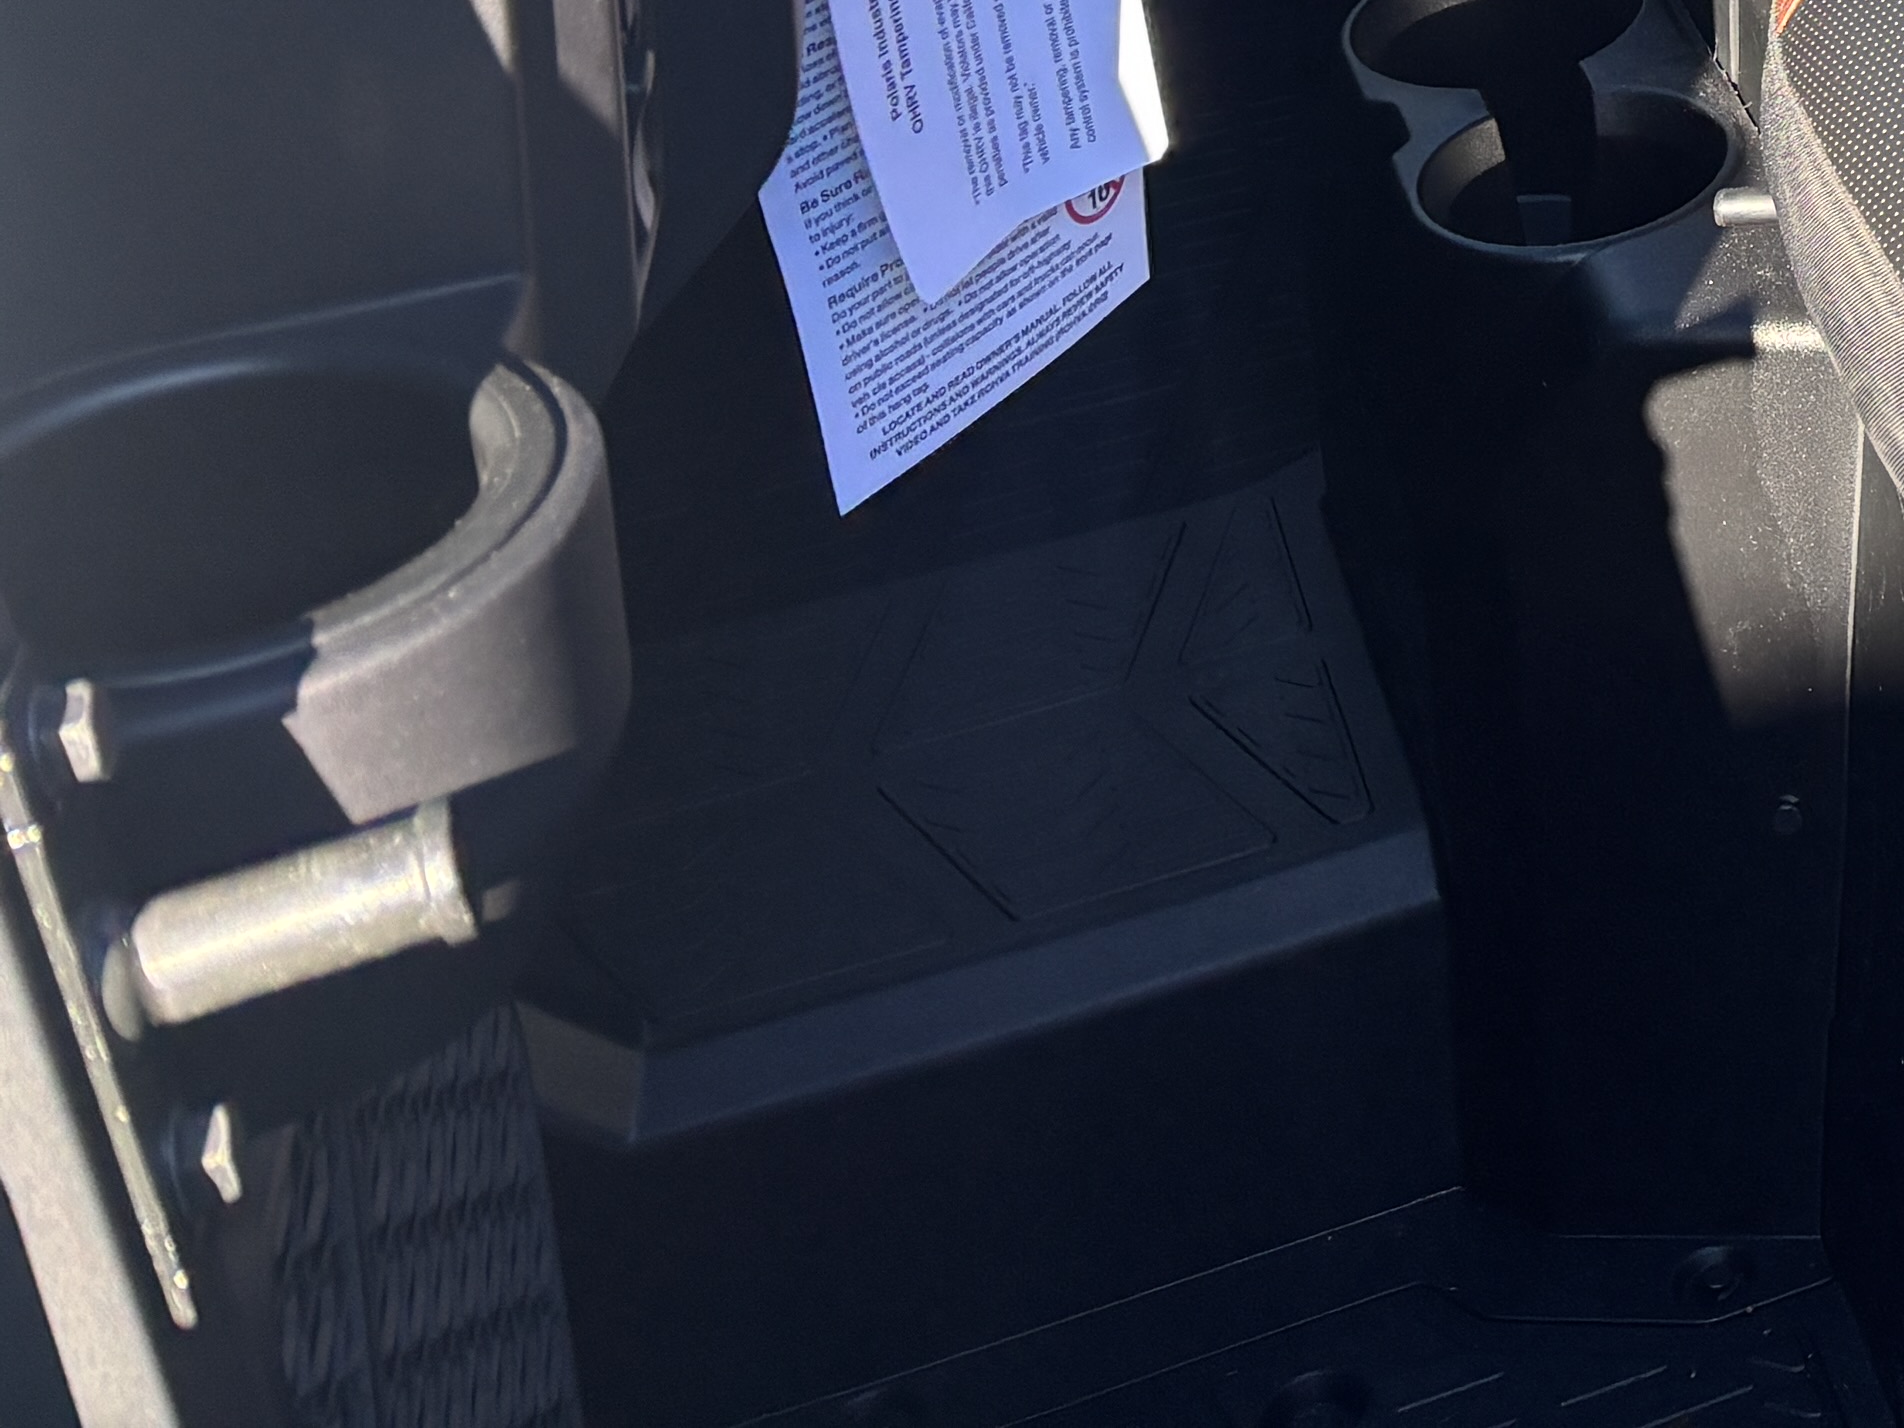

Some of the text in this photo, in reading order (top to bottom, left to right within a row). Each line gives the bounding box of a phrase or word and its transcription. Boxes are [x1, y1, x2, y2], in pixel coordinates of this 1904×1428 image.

[993, 3, 1012, 54] removed
[1043, 2, 1053, 14] or
[1045, 16, 1063, 63] removal
[1068, 48, 1079, 60] is
[1003, 55, 1015, 72] be
[1007, 73, 1019, 92] not
[1071, 60, 1089, 102] system
[880, 59, 902, 121] Polaris
[903, 83, 924, 133] OHRV
[1012, 95, 1026, 119] may
[1054, 64, 1077, 125] tampering,
[1017, 120, 1030, 141] tag
[1067, 127, 1082, 149] Any
[1079, 103, 1096, 143] control
[794, 151, 857, 194] Avoid paved
[800, 177, 851, 214] Be Sure
[810, 231, 819, 244] to
[821, 213, 876, 256] Keep a firm
[825, 231, 877, 269] Do not put
[828, 268, 878, 312] Require
[831, 273, 903, 324] Do your part to
[842, 289, 901, 334] Do not allow
[856, 392, 910, 434] of this hang
